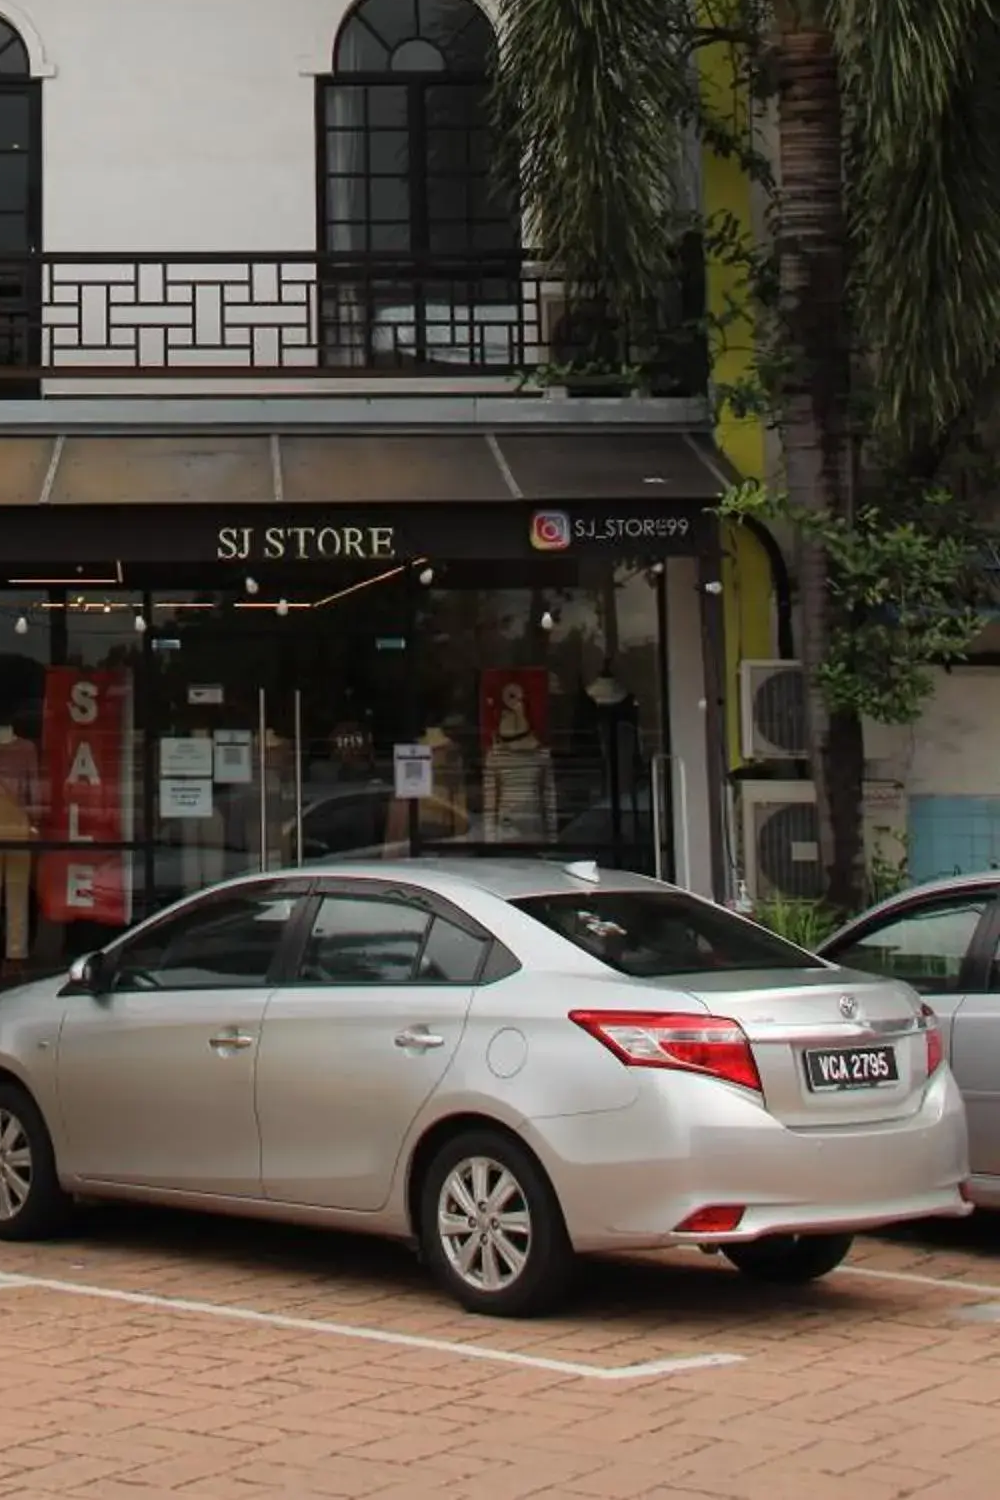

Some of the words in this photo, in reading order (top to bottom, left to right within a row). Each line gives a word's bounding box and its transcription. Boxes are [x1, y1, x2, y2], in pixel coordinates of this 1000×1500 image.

[217, 527, 253, 559] SJ
[265, 527, 395, 559] STORE
[575, 517, 689, 539] SJ_STORE99
[67, 681, 101, 907] SALE
[818, 1054, 849, 1080] VCA
[851, 1052, 889, 1078] 2795
